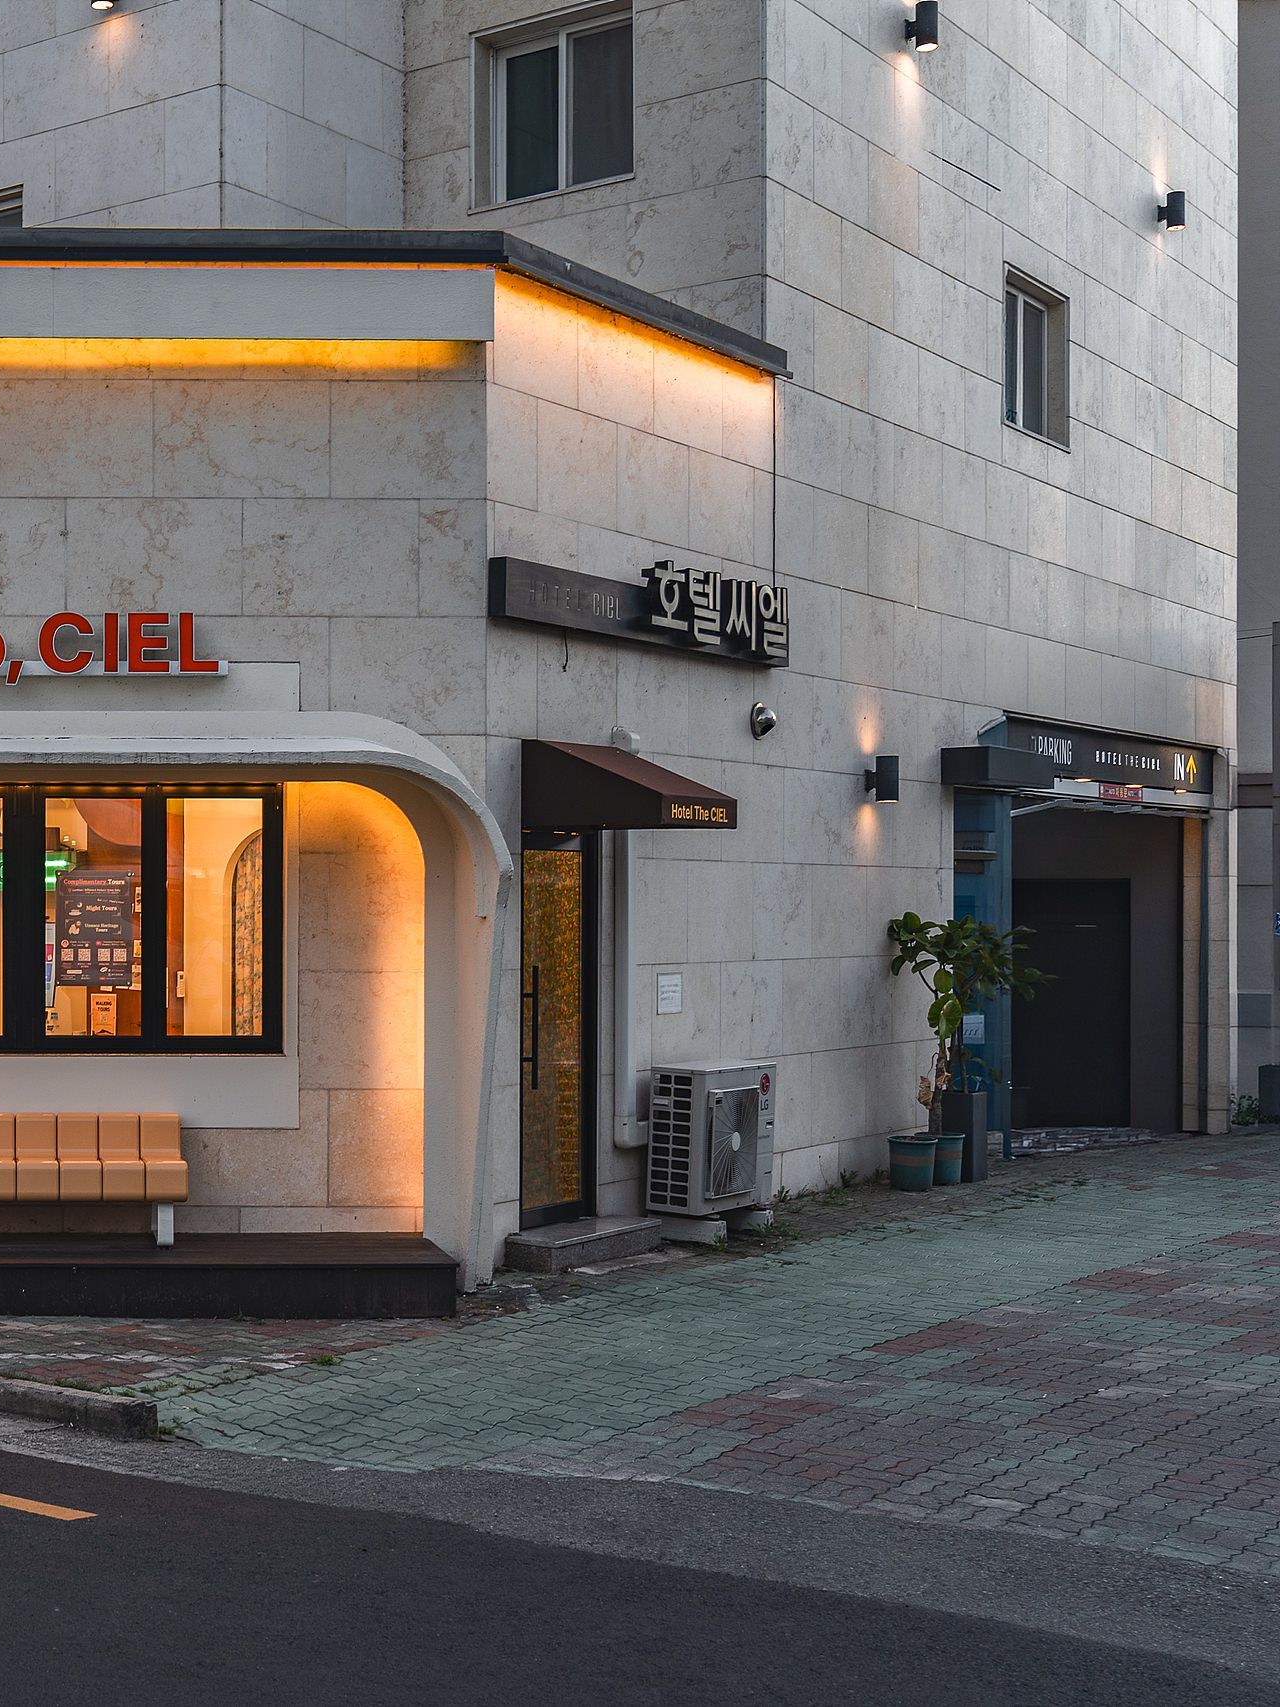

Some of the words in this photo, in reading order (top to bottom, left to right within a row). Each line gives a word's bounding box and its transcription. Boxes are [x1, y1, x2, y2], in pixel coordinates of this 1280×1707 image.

[528, 578, 584, 612] HOTEL
[37, 611, 220, 675] CIEL
[1038, 735, 1072, 766] PARKING
[1095, 750, 1122, 766] HOTEL
[1174, 753, 1185, 780] IN
[671, 803, 693, 819] Hotel
[694, 805, 710, 820] The
[710, 807, 728, 822] CIEL
[63, 878, 106, 886] Complimentary
[760, 1099, 769, 1110] LG
